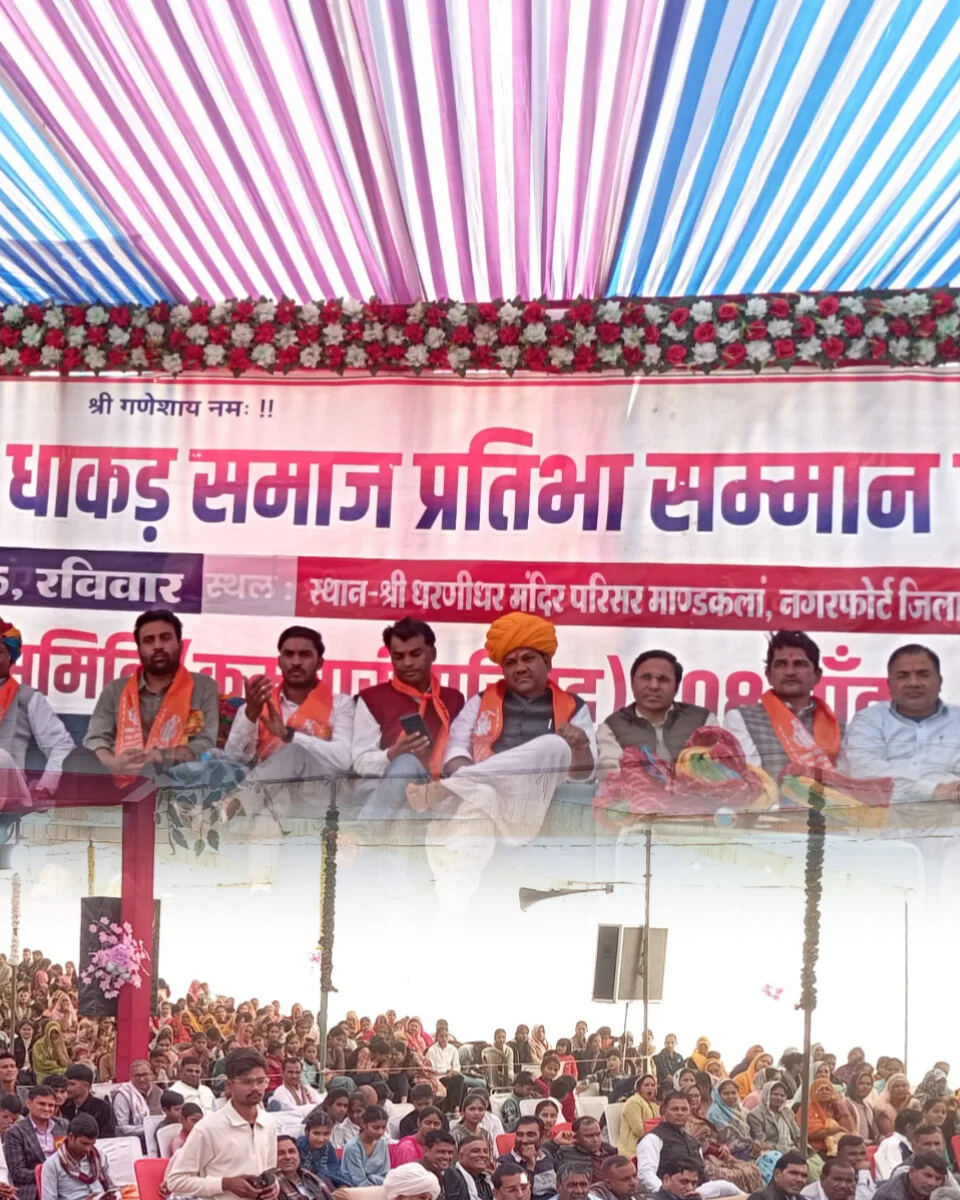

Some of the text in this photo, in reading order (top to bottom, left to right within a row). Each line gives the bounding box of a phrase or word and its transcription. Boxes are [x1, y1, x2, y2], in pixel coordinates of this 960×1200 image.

[89, 392, 114, 415] श्री
[120, 393, 201, 417] गणेशाय
[208, 399, 250, 417] नमः
[5, 443, 179, 543] धाकड़
[189, 448, 403, 529] समाज
[412, 426, 634, 532] प्रतिभा
[646, 452, 941, 534] सम्मान
[35, 556, 185, 604] रविवार
[411, 570, 505, 612] धरणीधर
[509, 570, 566, 617] मंदिर
[570, 572, 644, 615] परिसर
[779, 576, 895, 621] नगरफोर्ट
